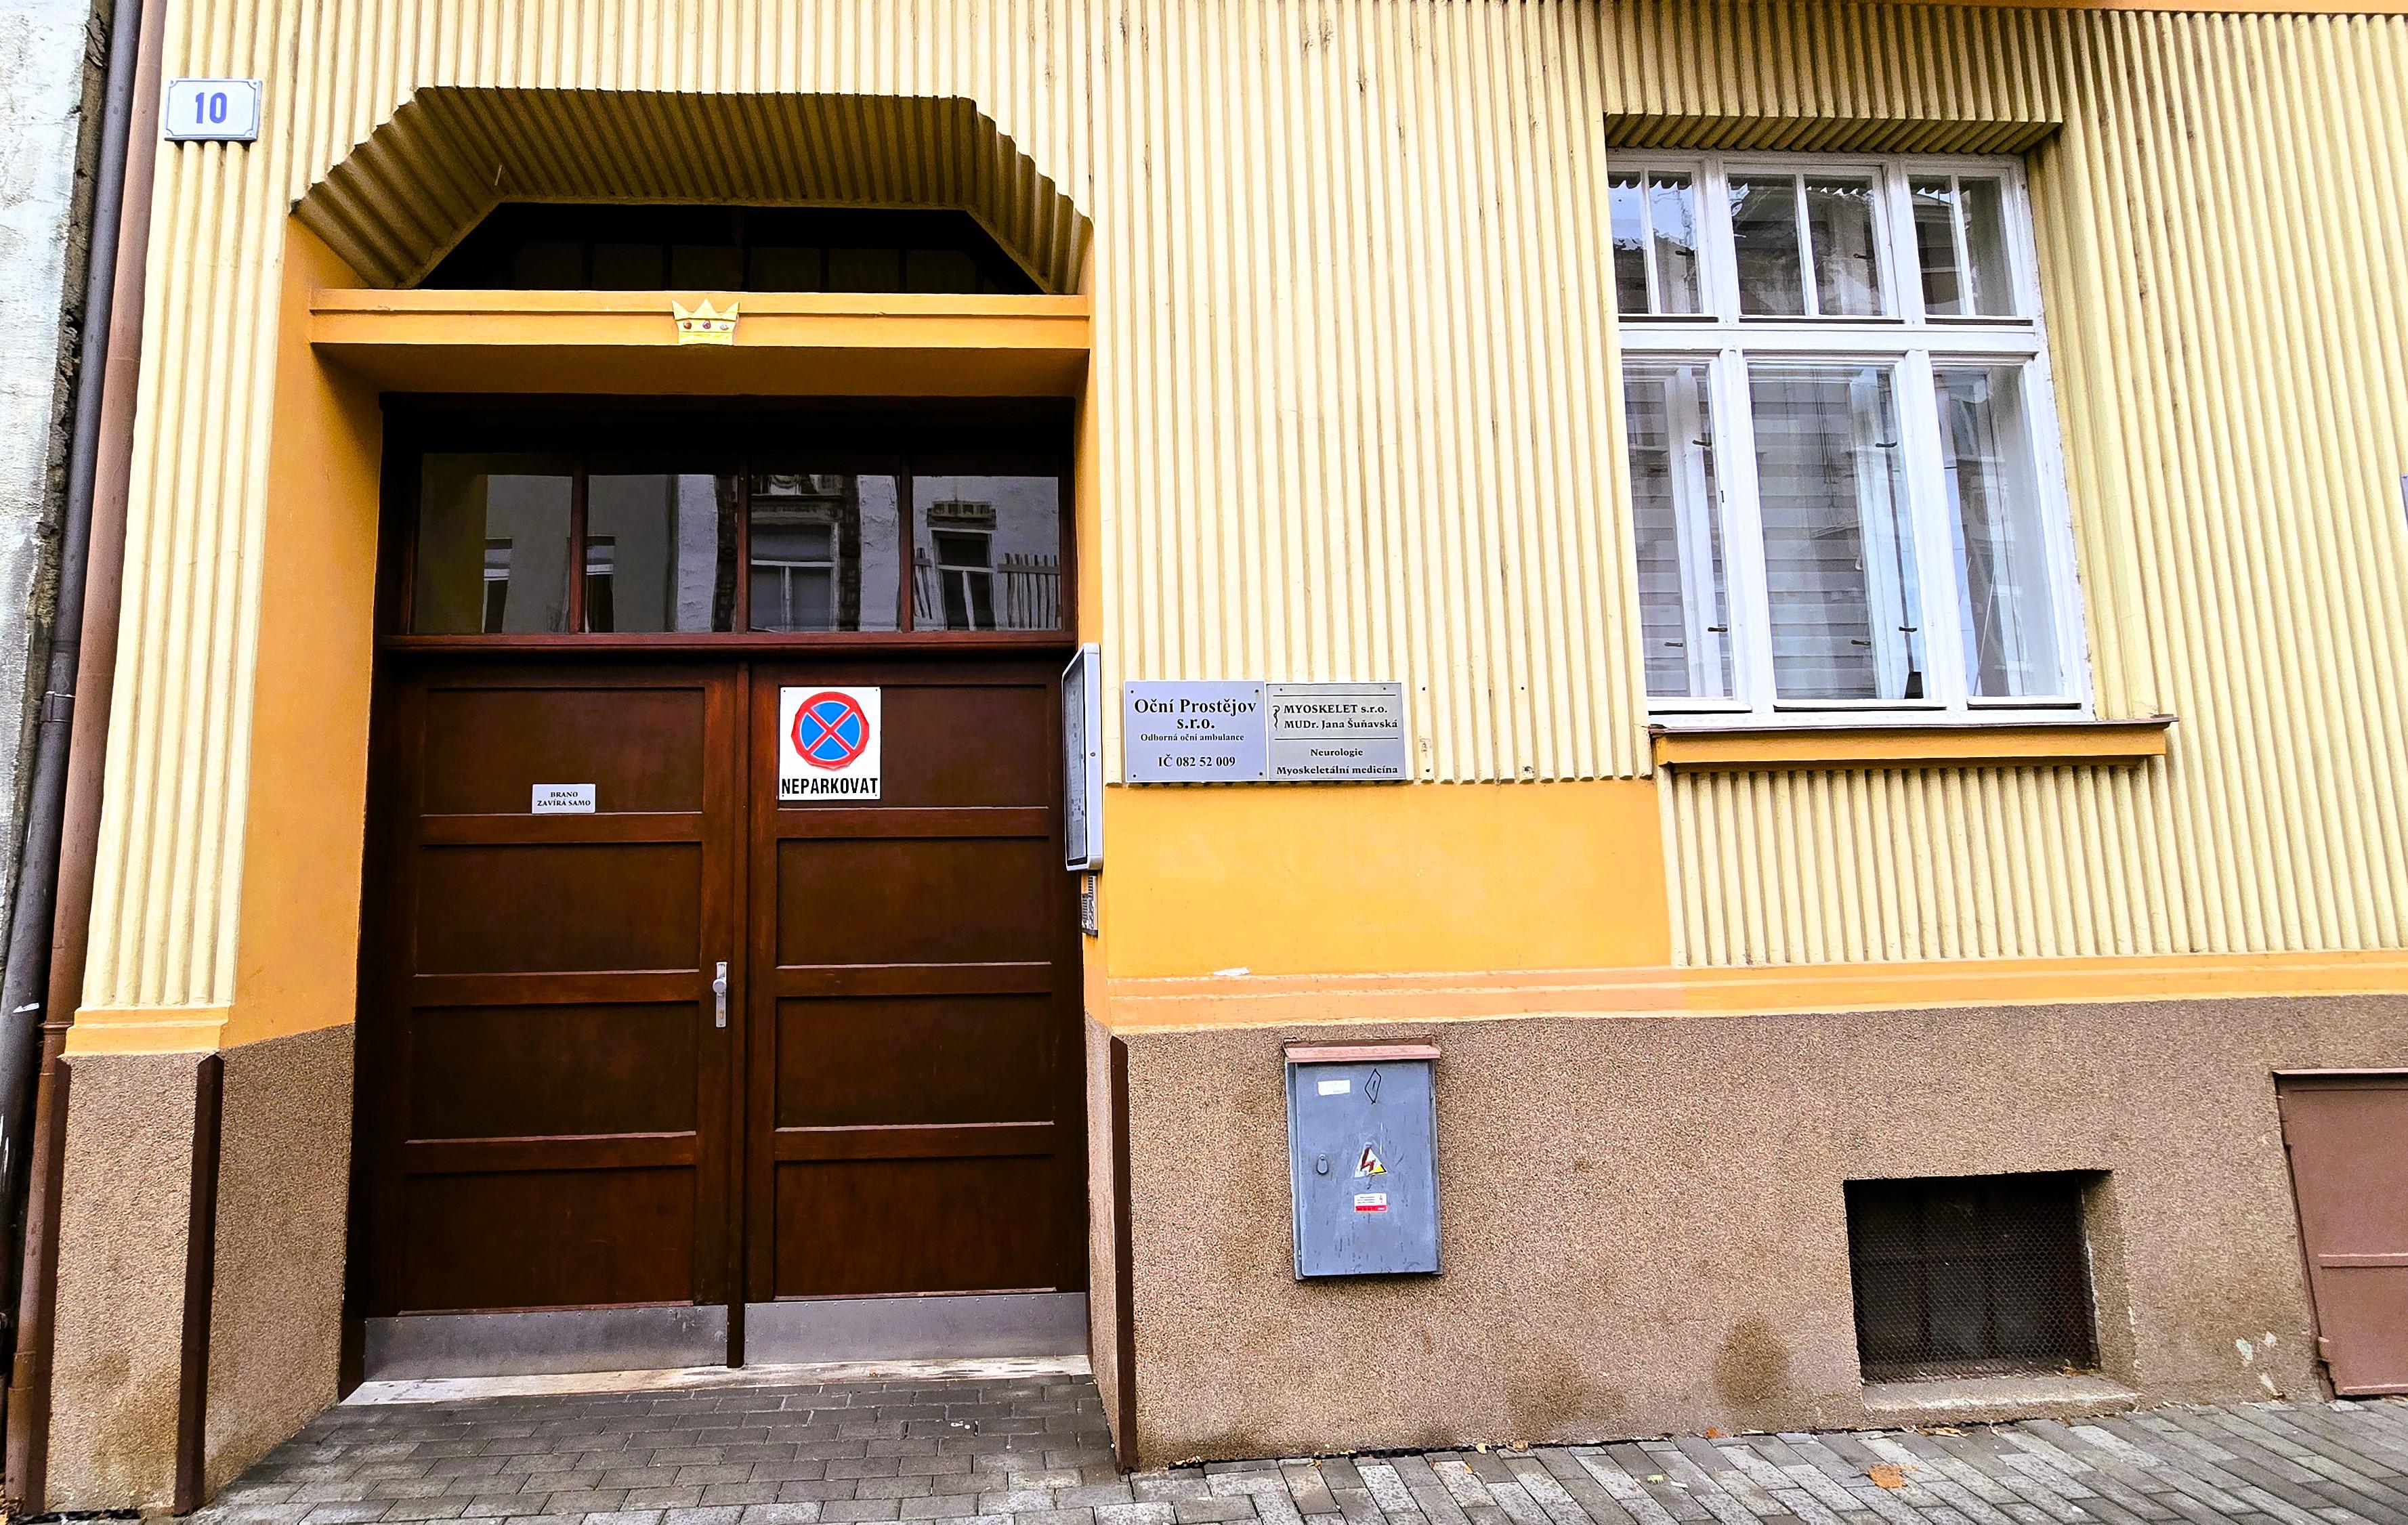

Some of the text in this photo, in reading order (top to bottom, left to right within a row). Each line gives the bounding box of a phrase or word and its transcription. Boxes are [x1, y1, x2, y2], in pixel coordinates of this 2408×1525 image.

[195, 92, 227, 123] 10
[1135, 699, 1256, 716] Oční Prostějov
[1284, 705, 1358, 714] MYOSKELET
[1177, 718, 1215, 729] s.r.o.
[1284, 718, 1398, 730] MUDr. Jana Šuňavská
[1140, 733, 1244, 742] Odborná oční ambulance
[1311, 748, 1364, 757] Neurologie
[1158, 754, 1235, 767] IČ 082 52 009
[1277, 765, 1398, 775] Myoskeletální medicína
[782, 778, 878, 794] NEPARKOVAT
